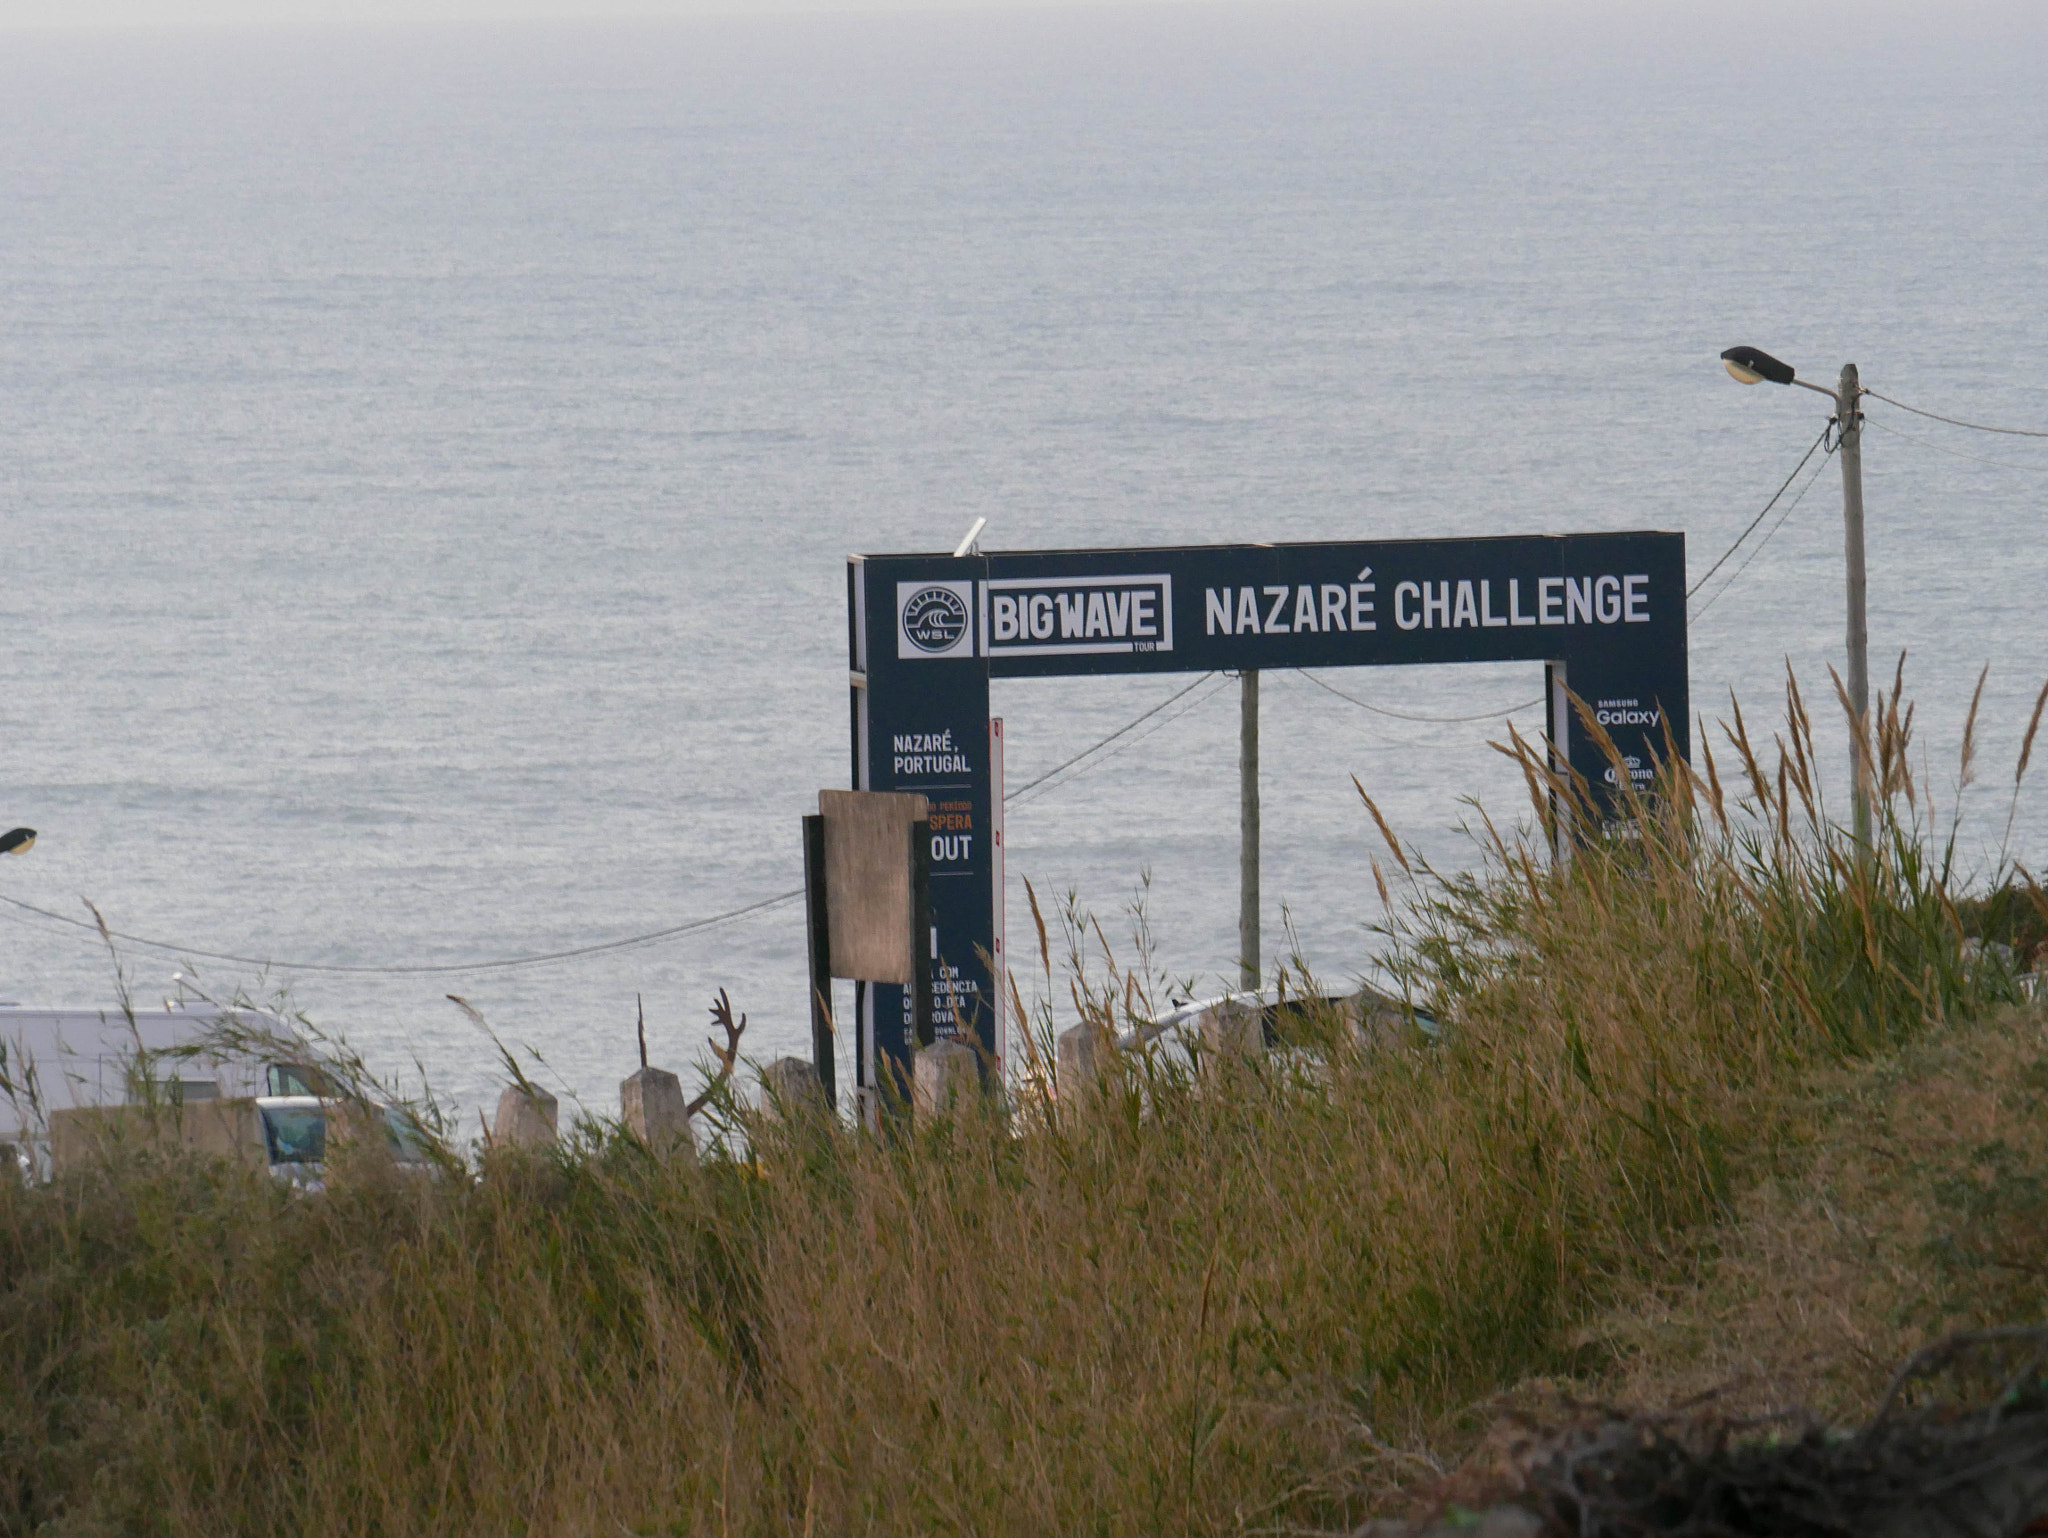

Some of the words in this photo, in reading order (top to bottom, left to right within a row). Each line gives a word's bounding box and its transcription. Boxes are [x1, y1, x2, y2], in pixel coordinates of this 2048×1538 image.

[1205, 566, 1377, 636] NAZARÉ
[1394, 574, 1650, 631] CHALLENGE
[916, 629, 955, 640] WSL
[1133, 641, 1155, 652] TOUR
[1598, 698, 1639, 708] SAMSUNG
[1596, 709, 1660, 728] Galaxy
[894, 728, 959, 753] NAZARÉ,
[894, 754, 972, 774] PORTUGAL
[931, 835, 972, 861] OUT
